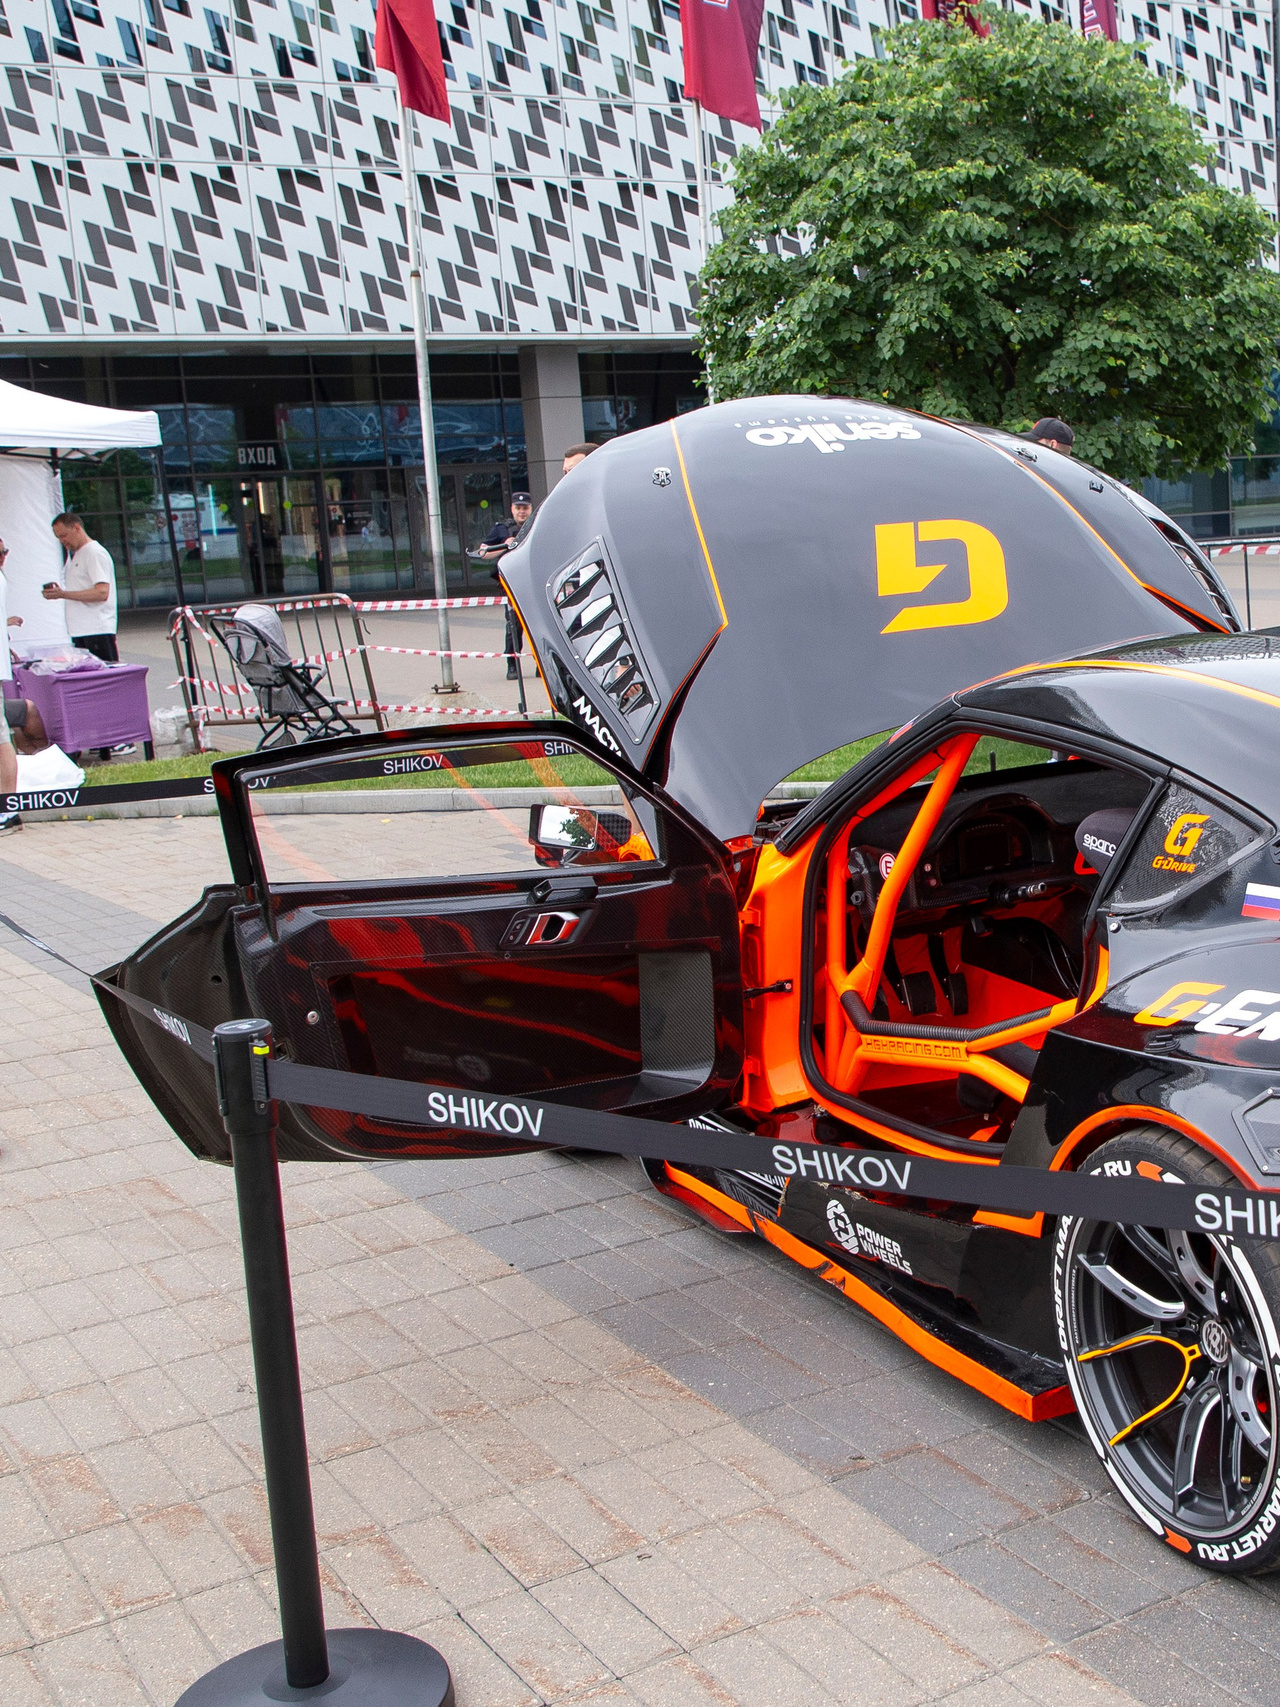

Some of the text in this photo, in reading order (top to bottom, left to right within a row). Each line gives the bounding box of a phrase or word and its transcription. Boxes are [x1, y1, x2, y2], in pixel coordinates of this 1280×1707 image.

[237, 446, 277, 466] ВХОД
[383, 754, 444, 775] SHIKOV
[6, 790, 80, 811] SHIKOV
[1083, 833, 1117, 857] sparc
[153, 1007, 192, 1045] SHIKOV
[428, 1091, 544, 1137] SHIKOV
[772, 1144, 912, 1190] SHIKOV
[856, 1222, 903, 1258] POWER
[859, 1238, 913, 1276] WHEELS
